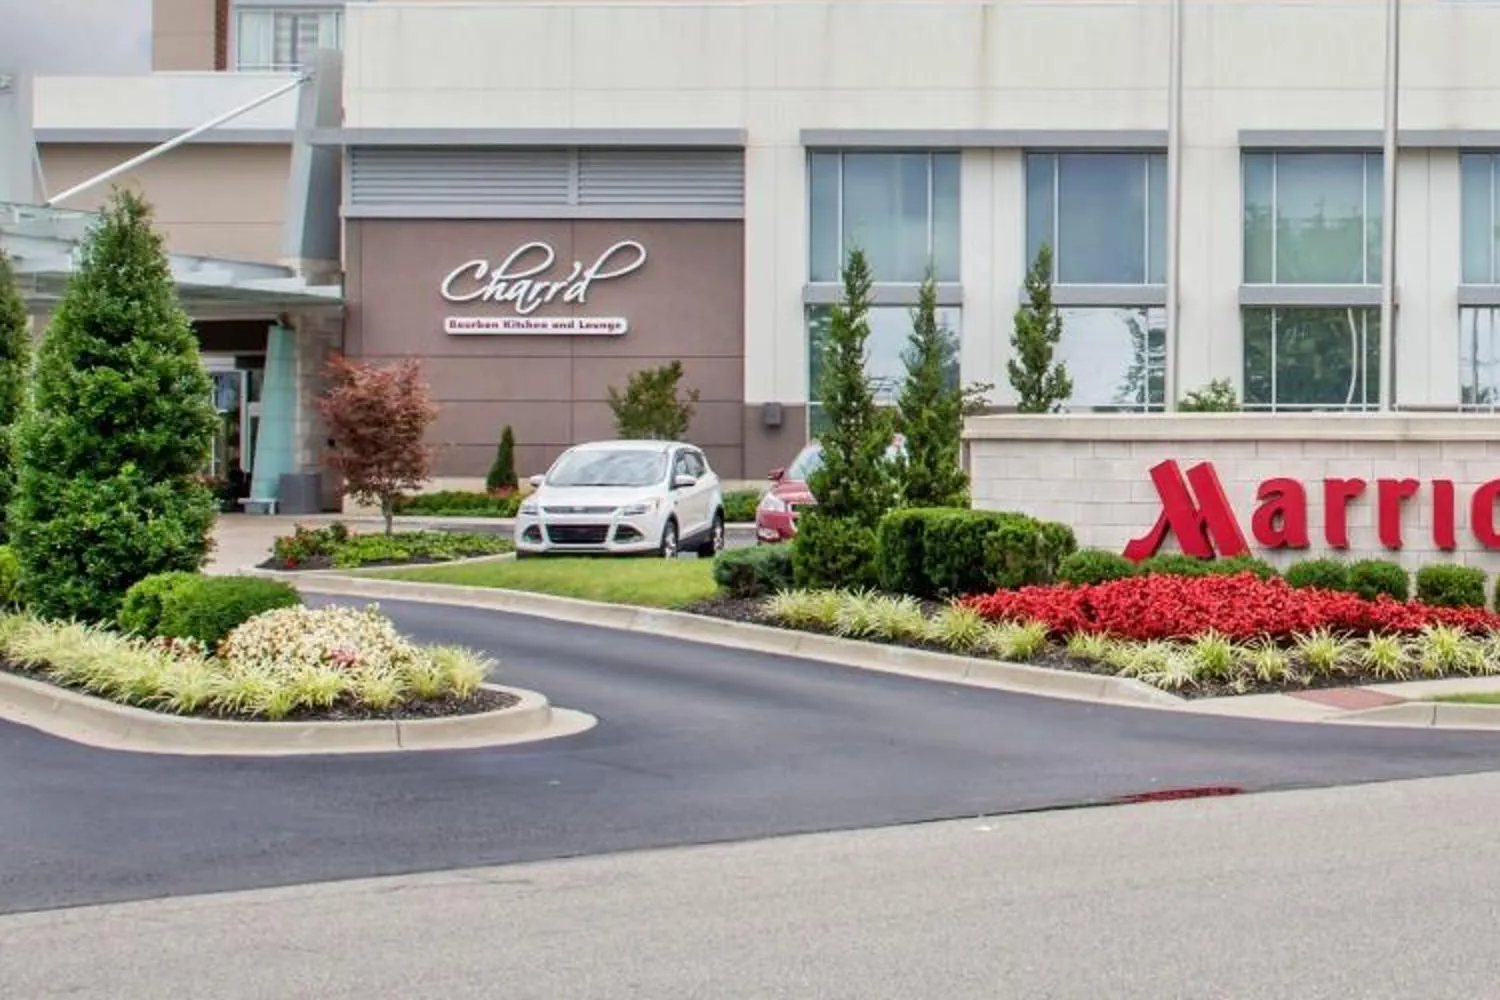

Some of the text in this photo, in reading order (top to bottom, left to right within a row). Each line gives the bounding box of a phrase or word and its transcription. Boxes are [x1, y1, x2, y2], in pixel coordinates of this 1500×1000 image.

[448, 319, 622, 332] Bourbon Kitchen and Lounge
